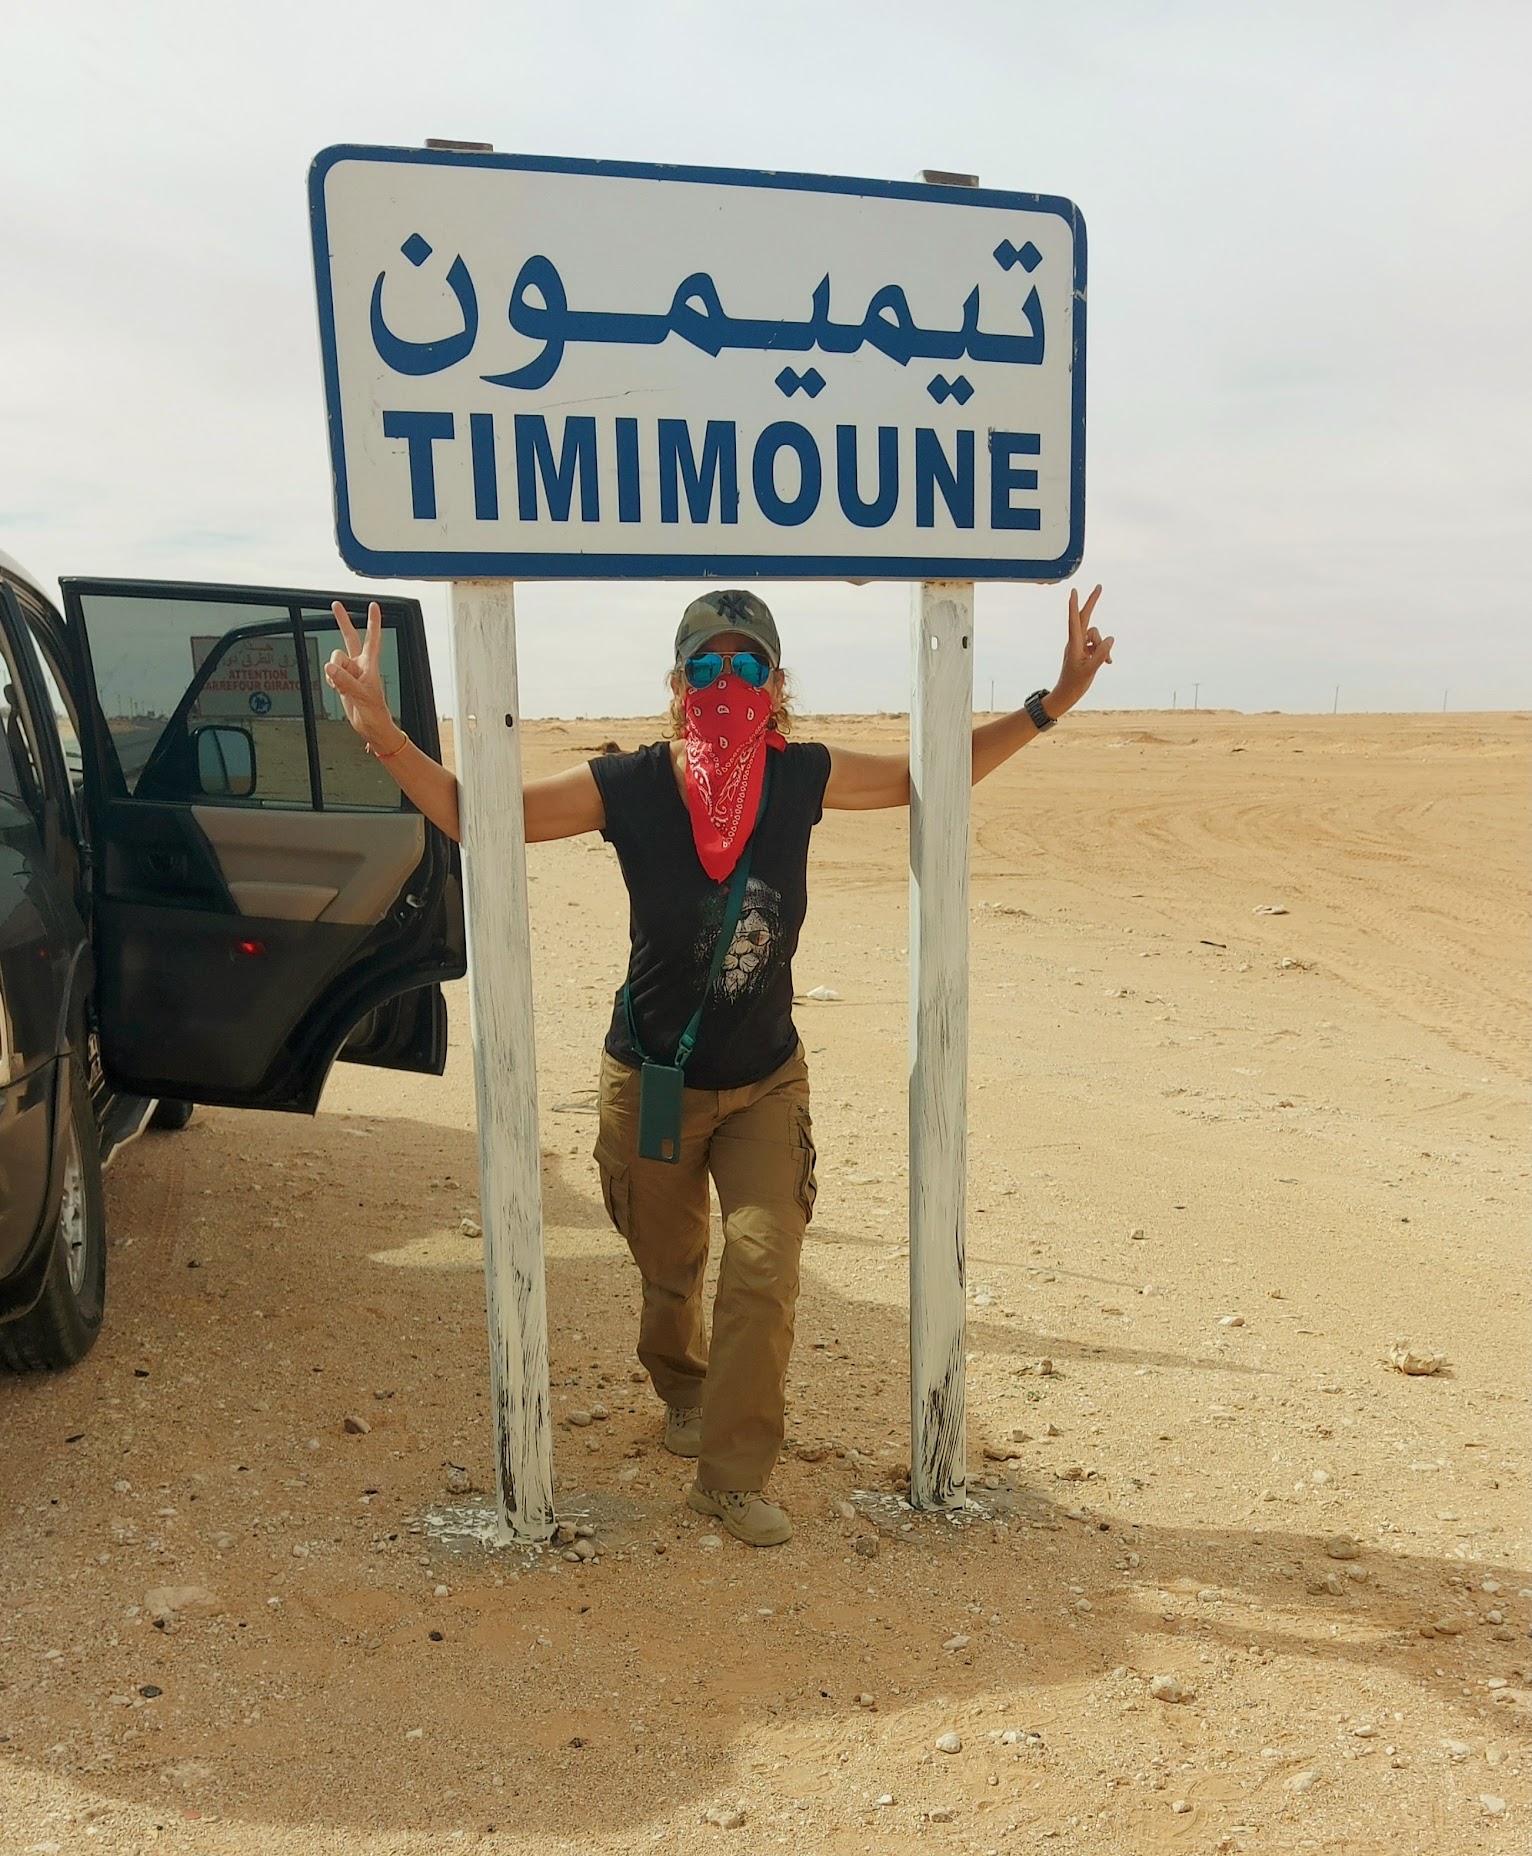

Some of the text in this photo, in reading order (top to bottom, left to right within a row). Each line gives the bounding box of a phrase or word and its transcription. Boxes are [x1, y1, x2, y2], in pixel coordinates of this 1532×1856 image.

[370, 233, 1045, 405] تيميمون
[383, 411, 1041, 530] TIMIMOUNE
[203, 681, 261, 691] ARREFOUR
[228, 669, 288, 680] ATTENTION
